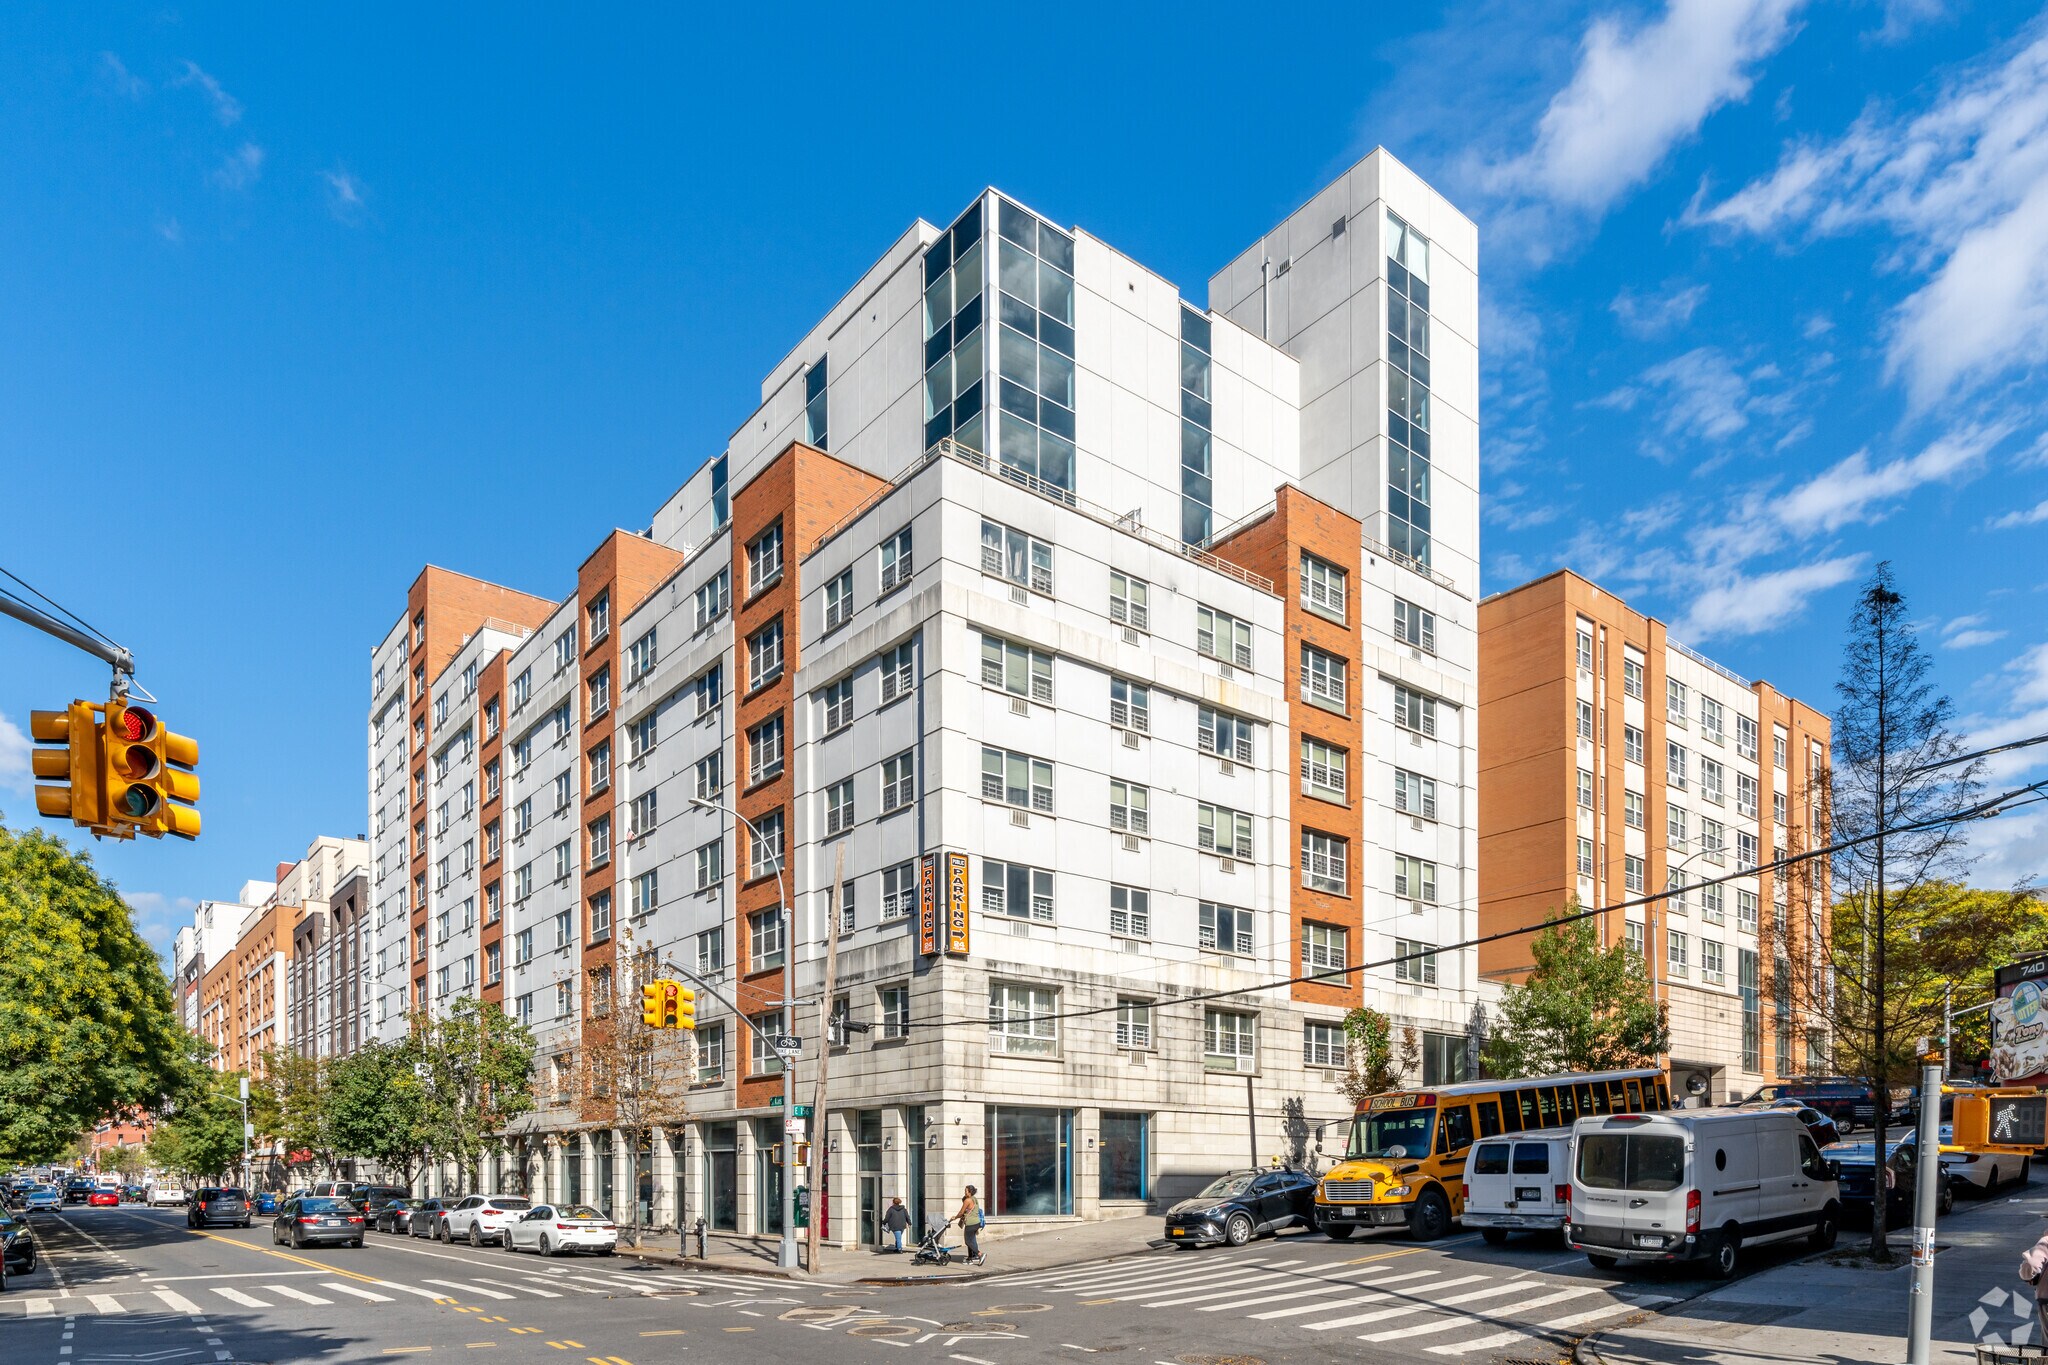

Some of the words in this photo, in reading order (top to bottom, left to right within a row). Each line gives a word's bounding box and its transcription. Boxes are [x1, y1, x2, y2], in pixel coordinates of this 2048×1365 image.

[924, 869, 932, 928] PARKING
[952, 868, 964, 928] PARKING
[2021, 961, 2045, 976] 740
[2015, 1023, 2042, 1038] Tony
[1372, 1098, 1396, 1108] SCHOOL
[1400, 1096, 1414, 1107] BUS
[794, 1106, 798, 1115] E
[800, 1107, 810, 1116] 156
